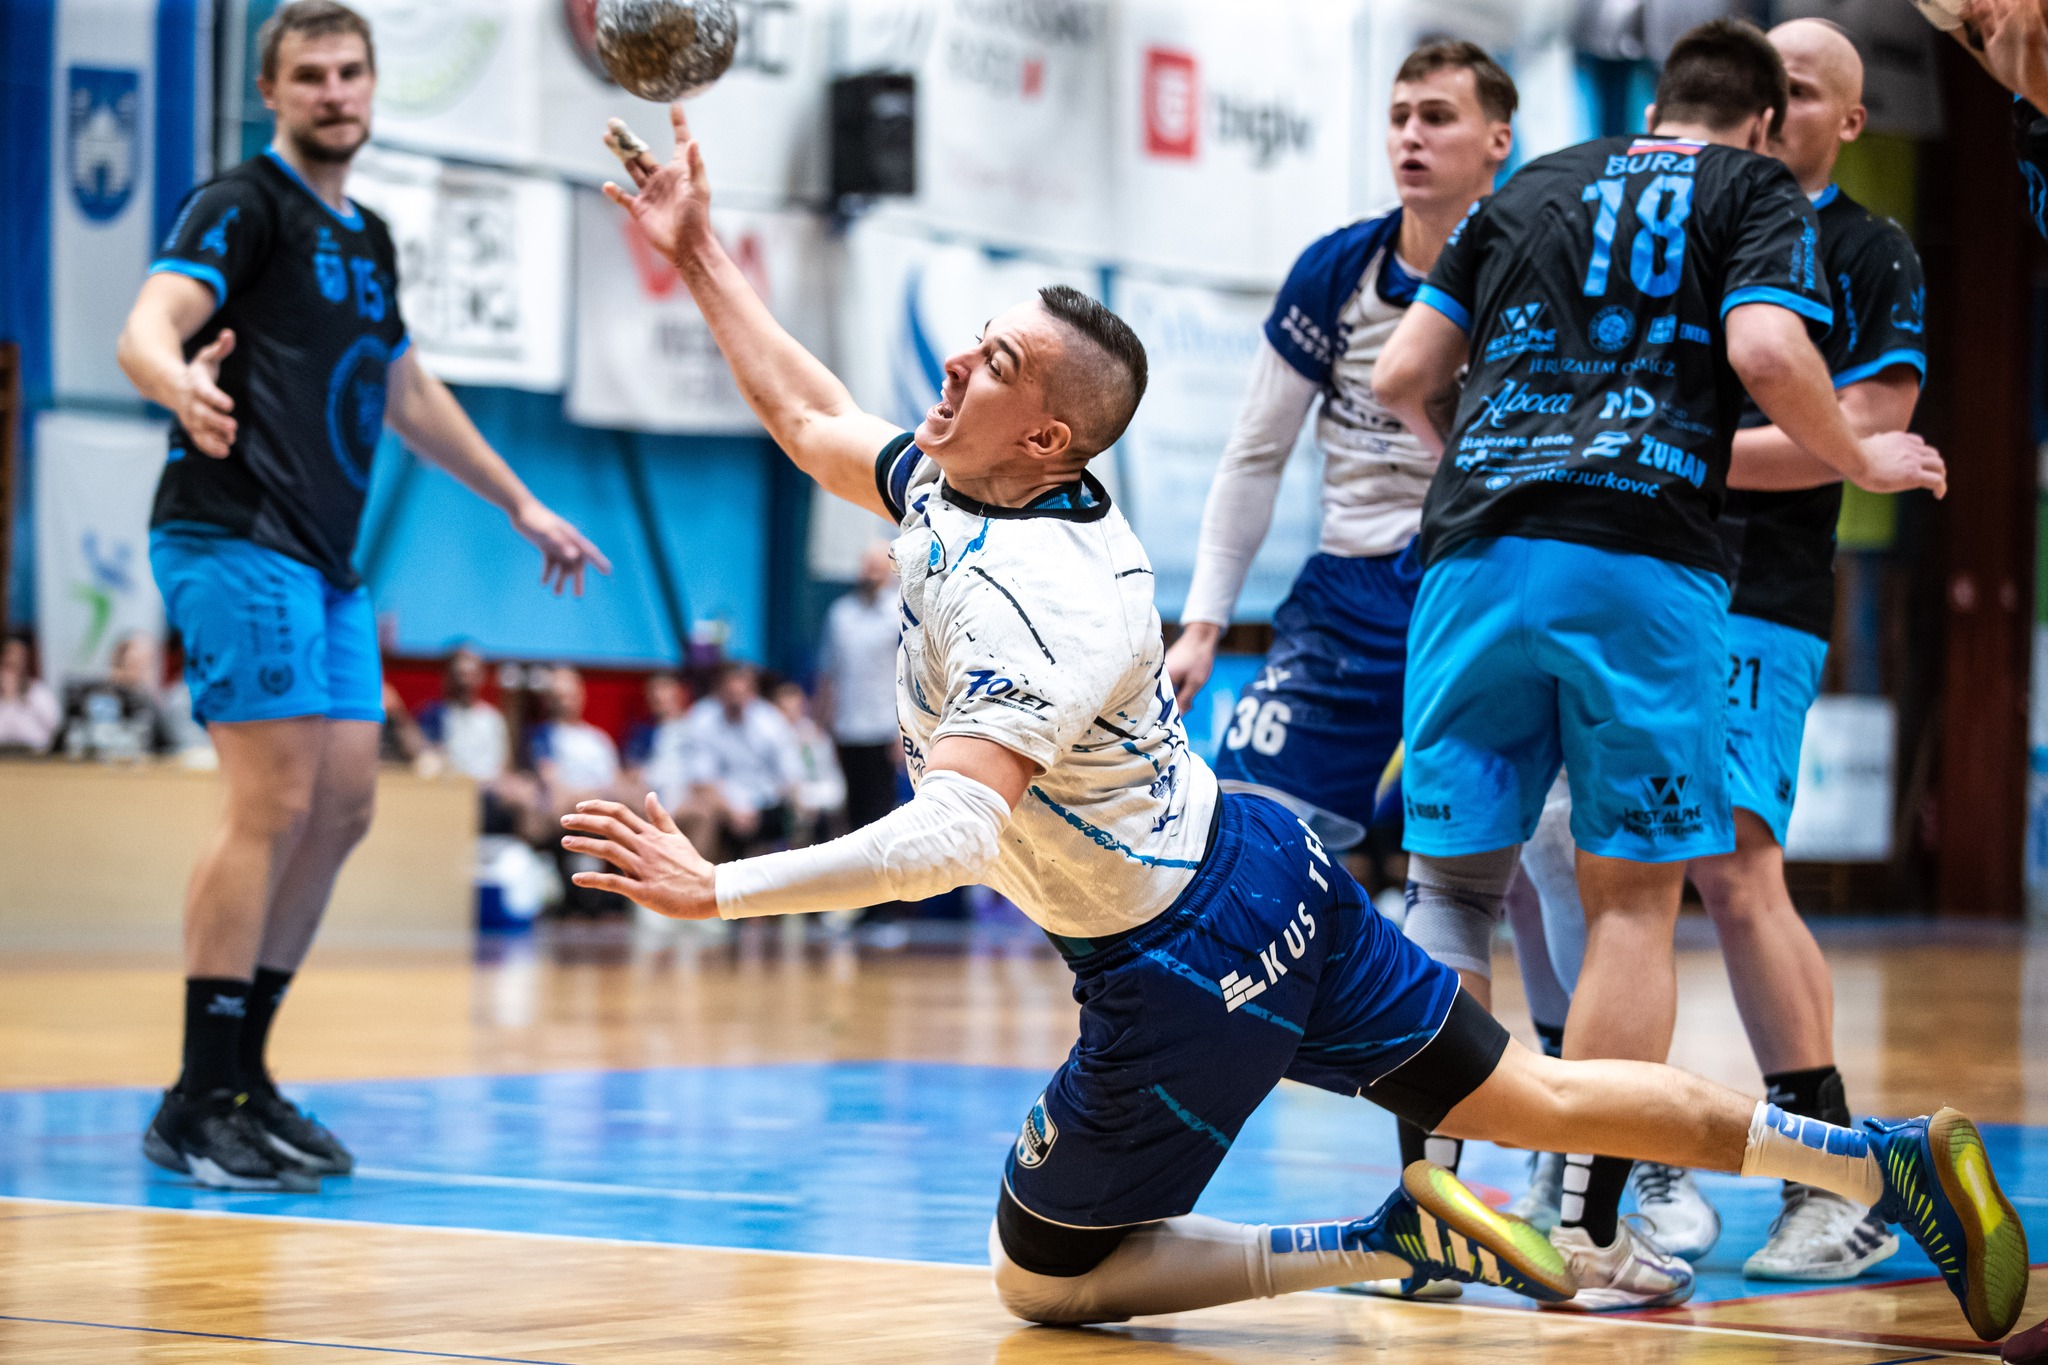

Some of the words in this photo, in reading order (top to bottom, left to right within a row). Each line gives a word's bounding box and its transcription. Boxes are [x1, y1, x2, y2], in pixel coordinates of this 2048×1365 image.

[1604, 152, 1697, 177] BURA
[1581, 173, 1696, 299] 18
[1529, 357, 1617, 375] JERUZALEM
[1226, 695, 1292, 757] 36
